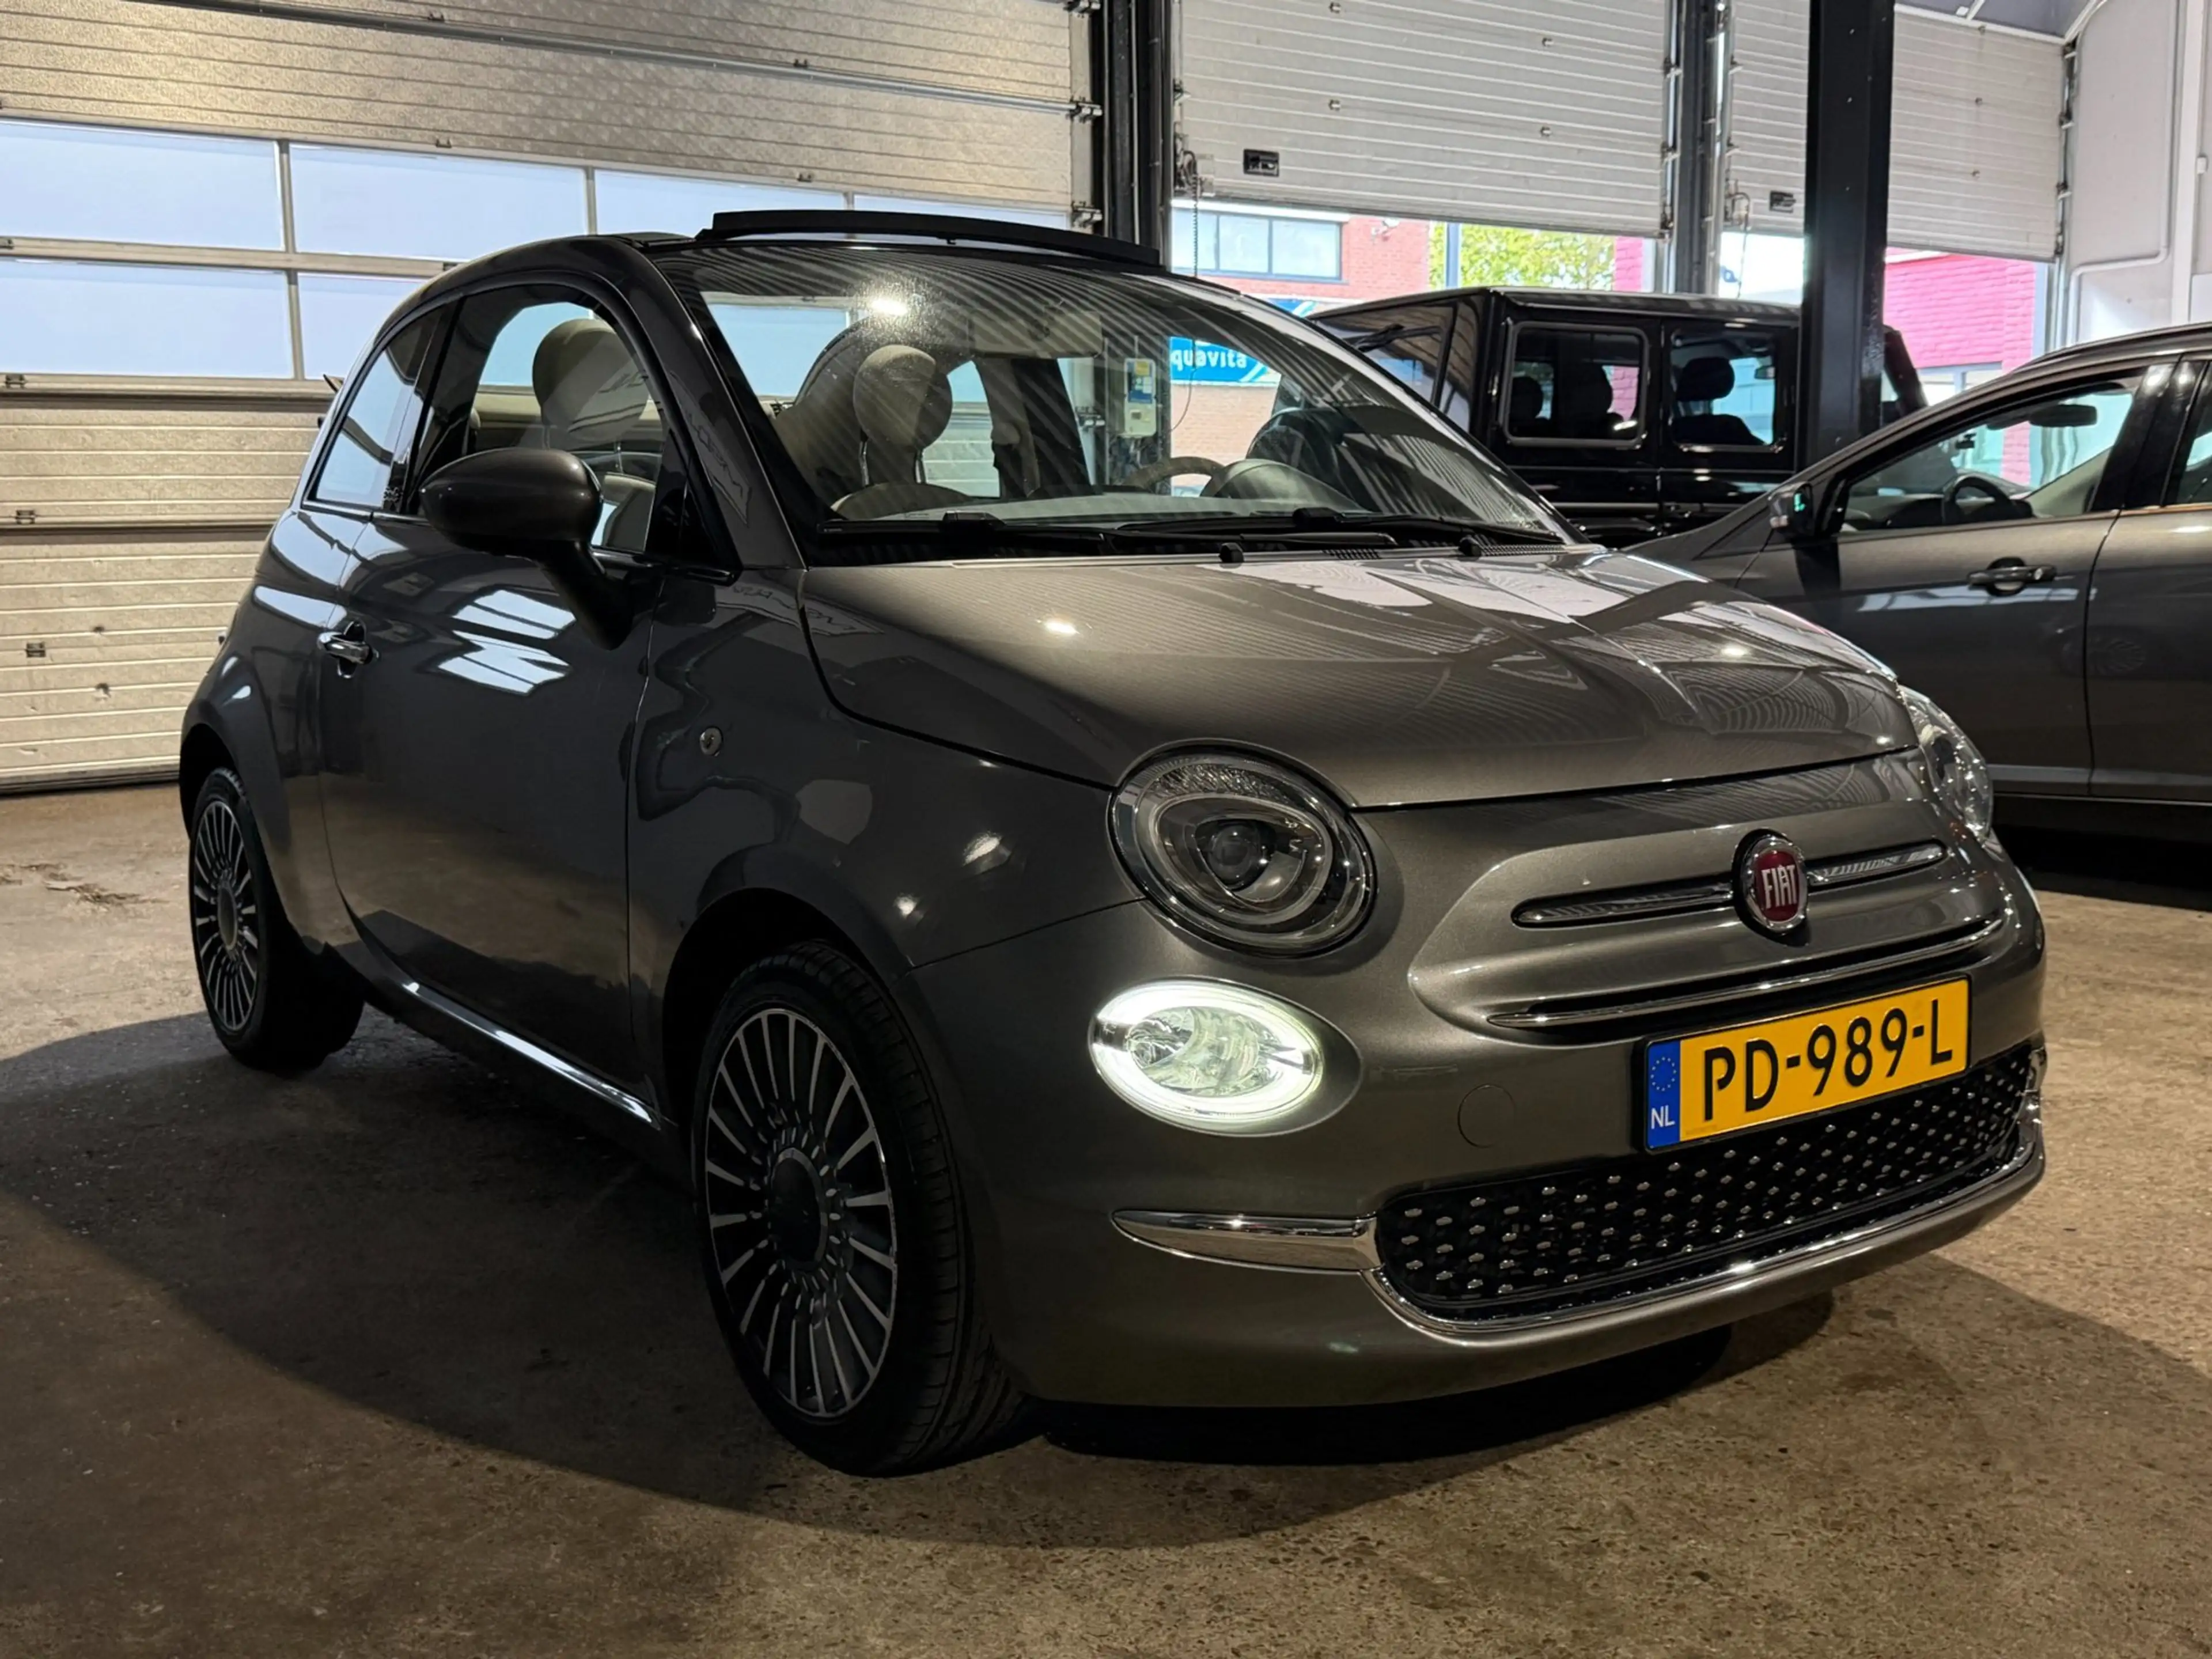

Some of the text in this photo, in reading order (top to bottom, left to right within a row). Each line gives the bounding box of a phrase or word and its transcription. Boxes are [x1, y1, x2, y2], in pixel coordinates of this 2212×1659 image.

[1761, 864, 1797, 909] FIAT
[1703, 998, 1953, 1121] PD-989-L
[1651, 1105, 1676, 1129] NL
